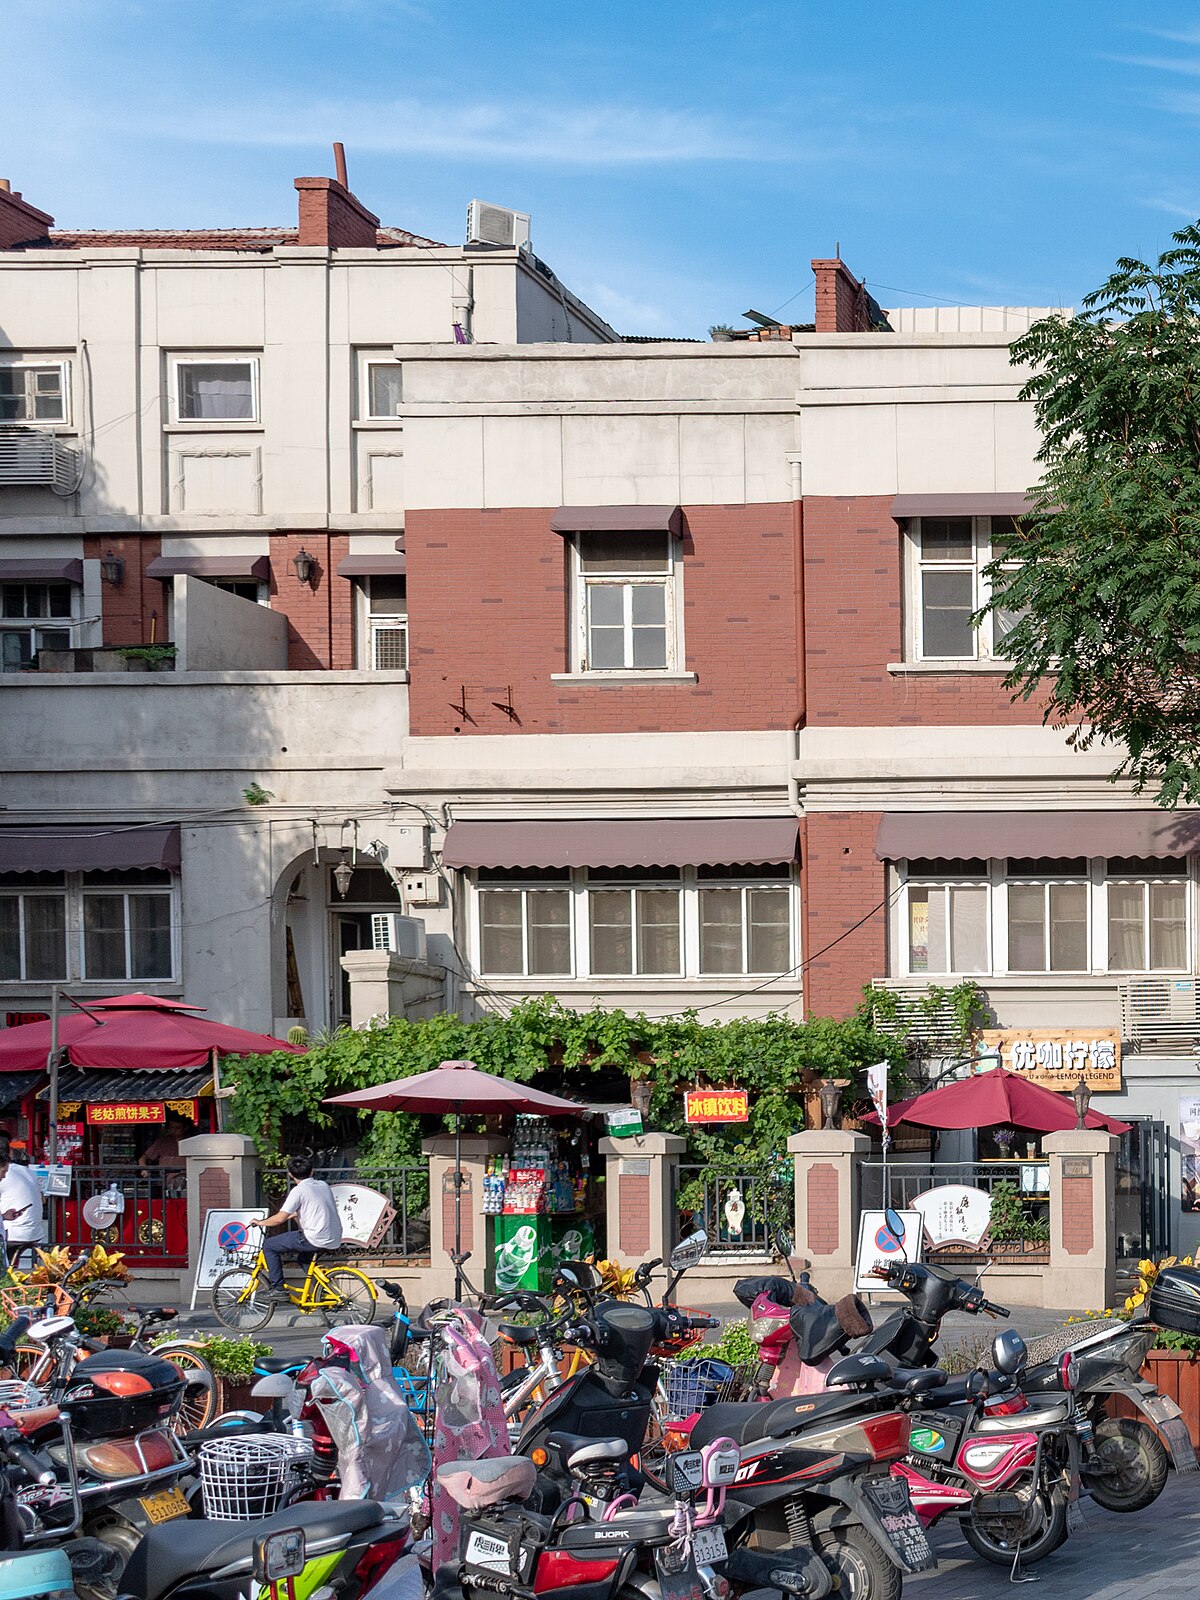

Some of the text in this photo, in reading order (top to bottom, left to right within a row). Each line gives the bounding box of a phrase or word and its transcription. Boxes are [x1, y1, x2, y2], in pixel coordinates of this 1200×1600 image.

[1010, 1040, 1116, 1070] 优咖柠檬
[91, 1107, 161, 1121] 老姑煎饼果子
[688, 1097, 747, 1117] 冰镇饮料
[151, 1500, 188, 1520] 5110965
[694, 1542, 727, 1563] 313152
